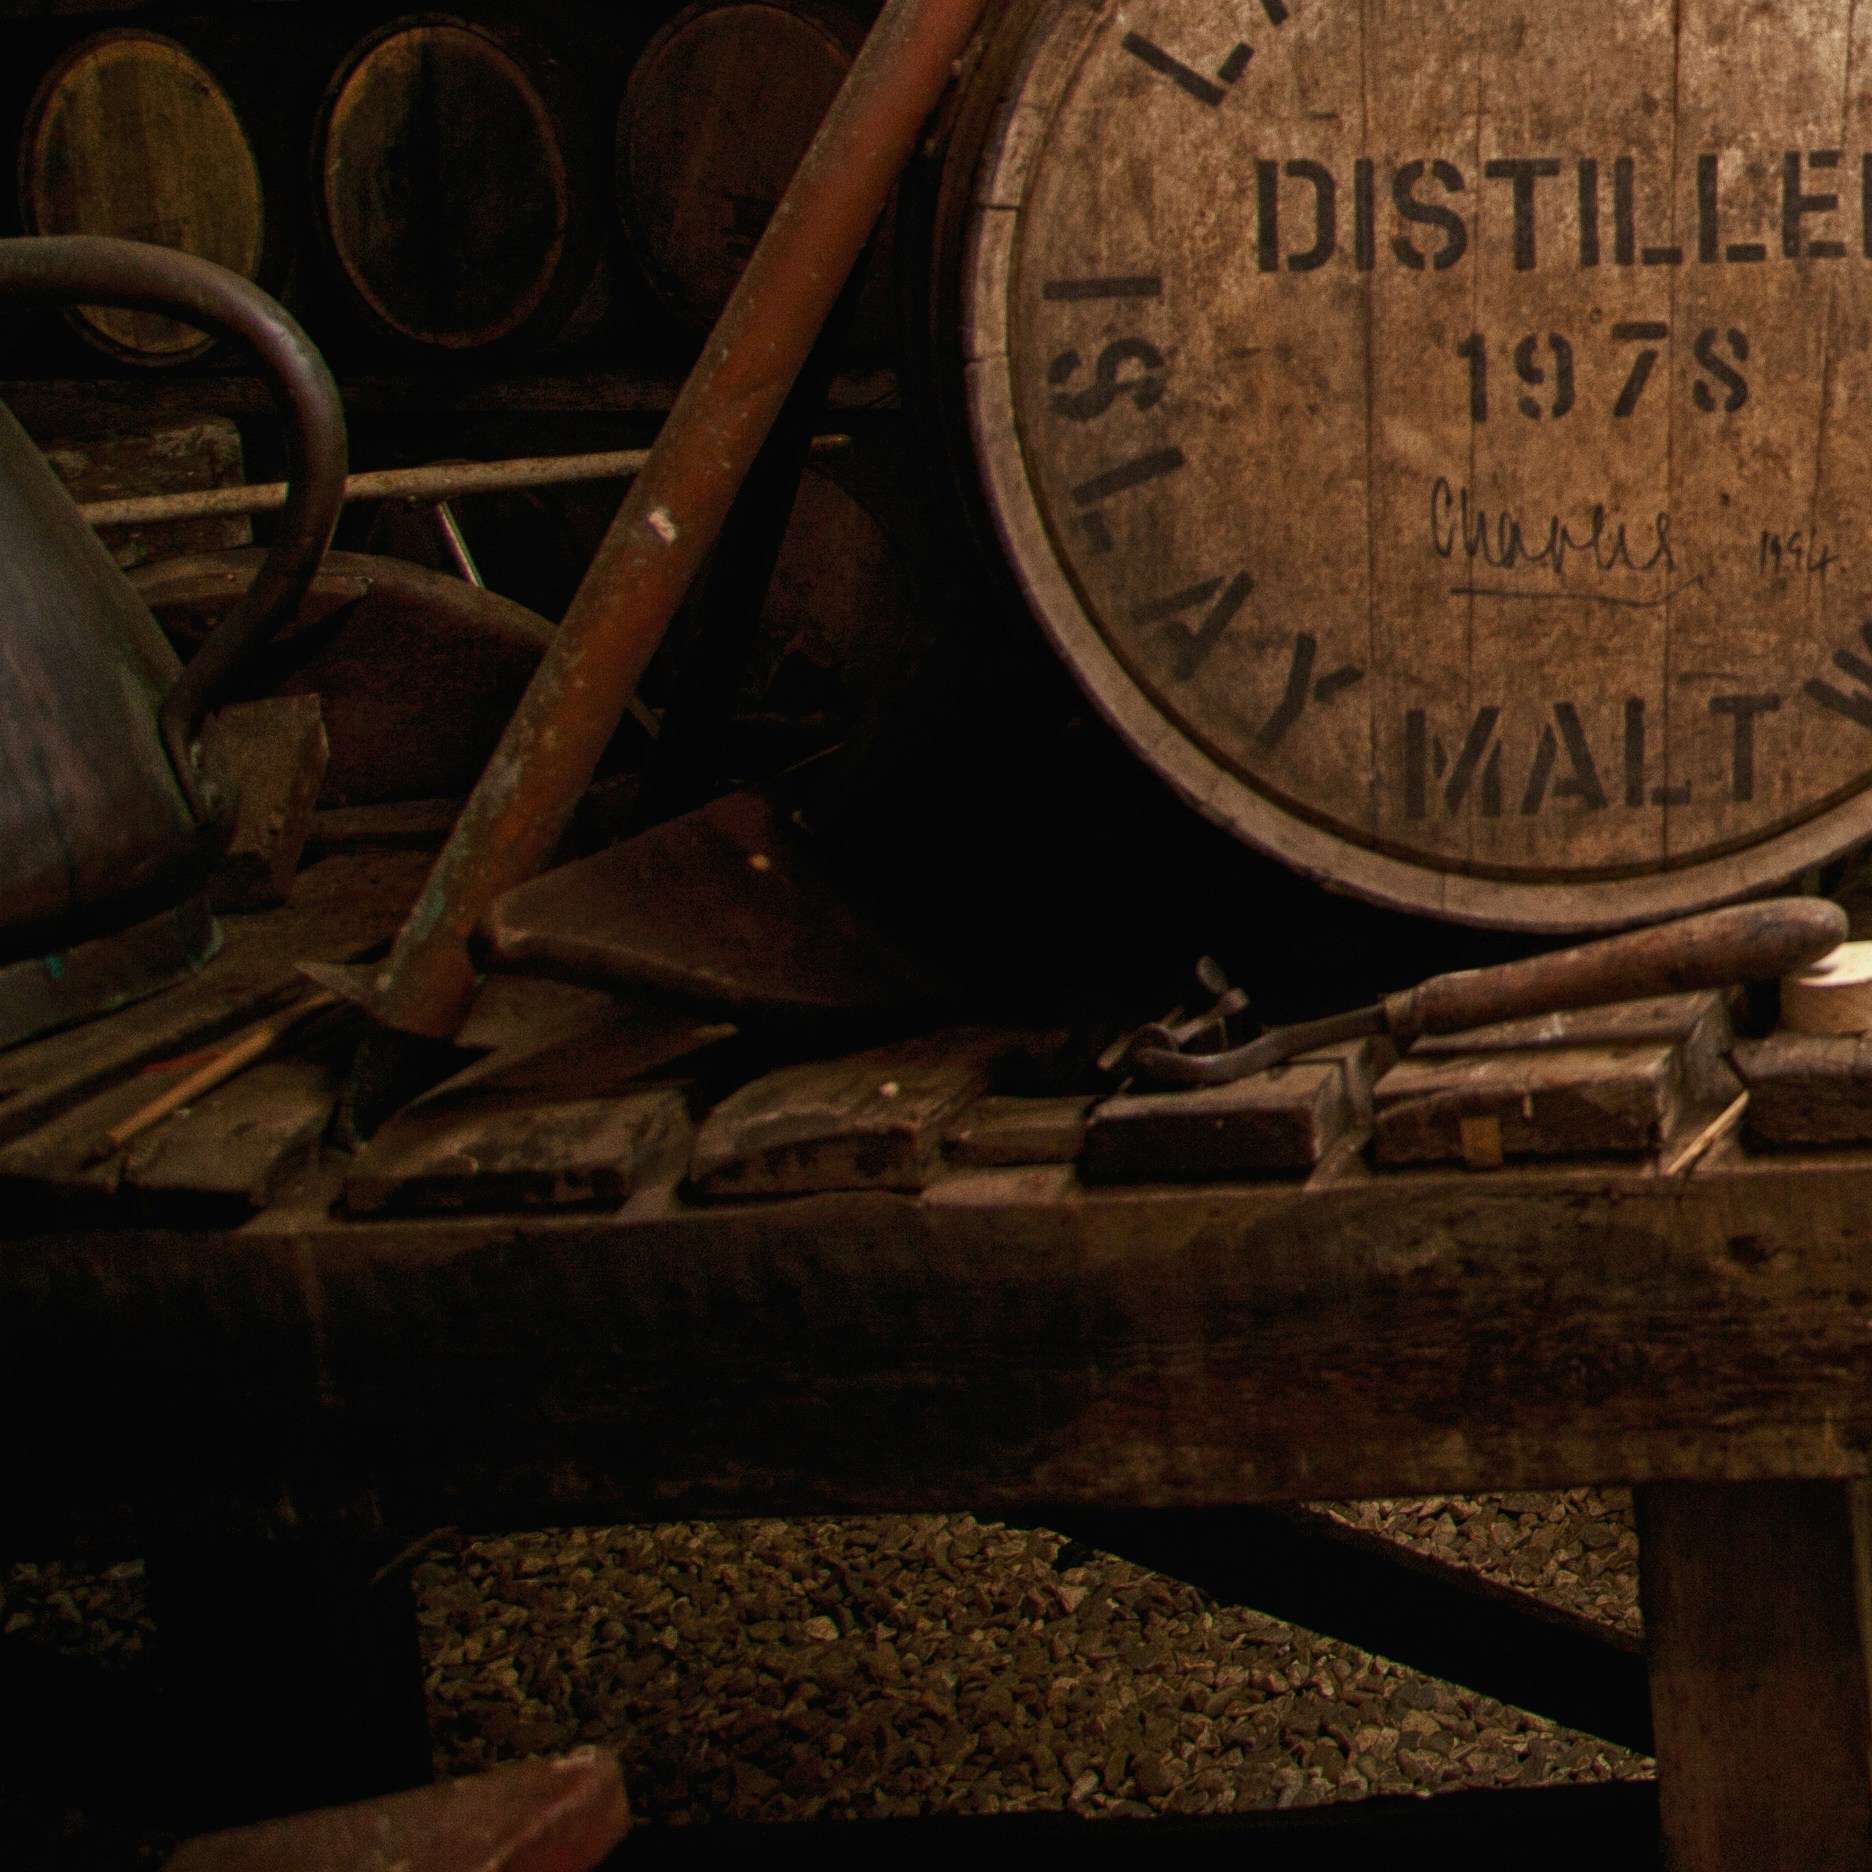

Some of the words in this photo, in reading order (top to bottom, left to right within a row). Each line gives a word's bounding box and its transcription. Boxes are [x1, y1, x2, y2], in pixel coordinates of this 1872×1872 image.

[1456, 320, 1748, 424] 1978
[1042, 274, 1366, 754] ISLAY
[1399, 689, 1782, 819] MALT
